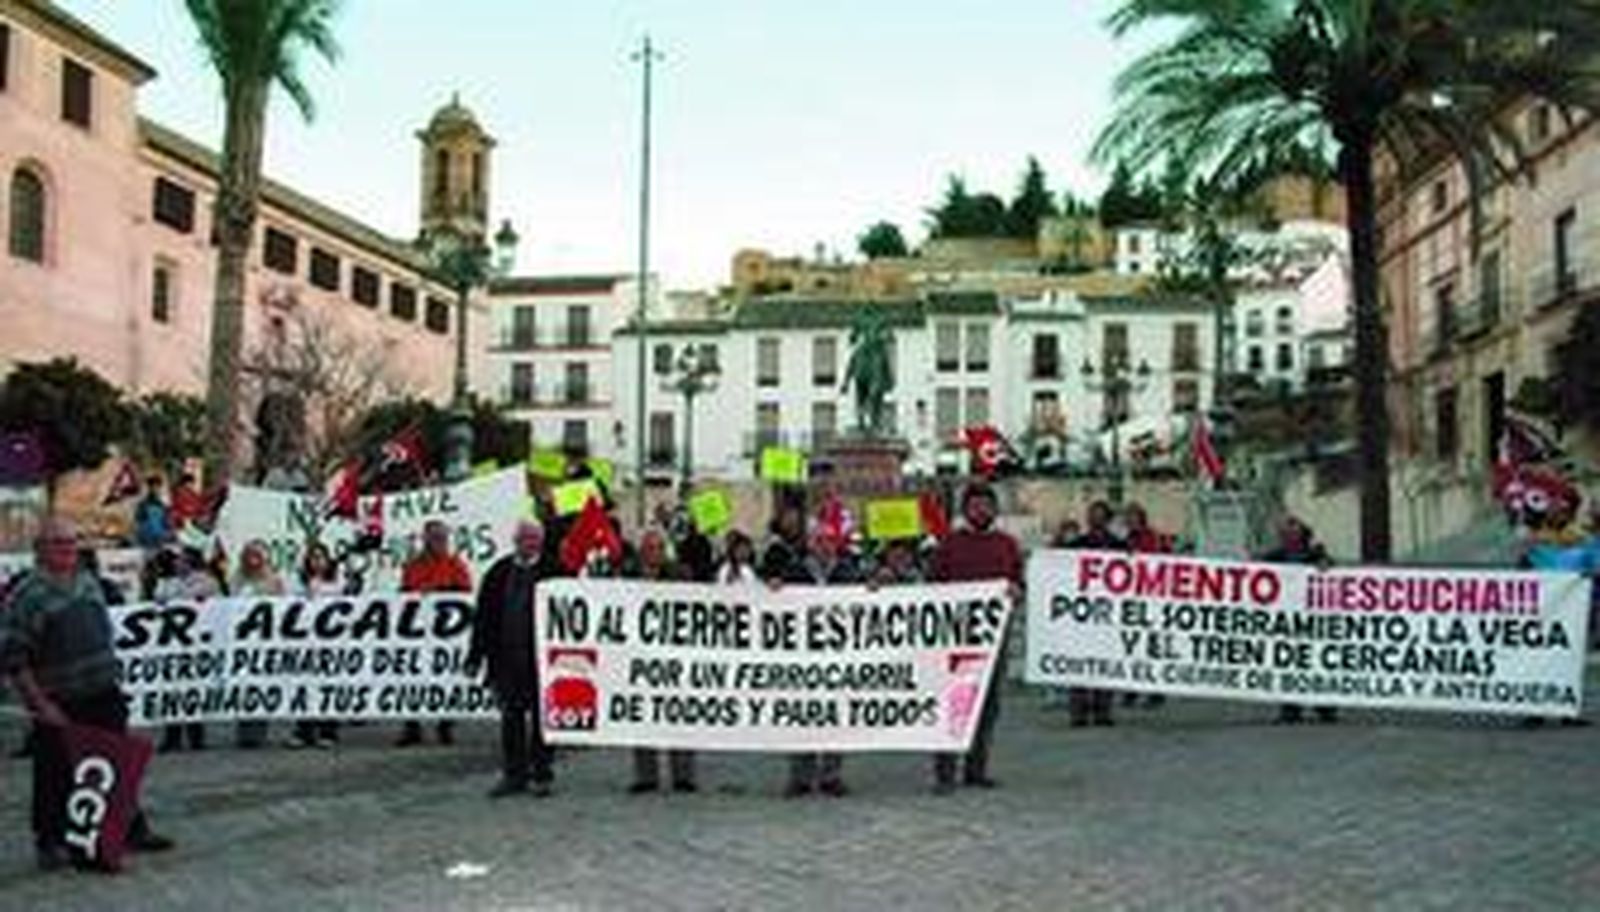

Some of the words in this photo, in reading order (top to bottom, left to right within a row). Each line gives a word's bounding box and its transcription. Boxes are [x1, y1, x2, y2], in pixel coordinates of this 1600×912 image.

[1078, 559, 1281, 604] FOMENTO
[115, 606, 212, 648] SR.
[235, 600, 472, 641] ALCALD
[547, 596, 589, 642] NO
[597, 605, 627, 642] AL
[639, 600, 750, 648] CIERRE
[761, 611, 797, 649] DE
[807, 599, 1004, 650] ESTACIONES
[1051, 596, 1112, 626] POR
[1121, 601, 1150, 628] EL
[1428, 618, 1468, 645] LA
[1479, 620, 1570, 649] VEGA
[231, 648, 364, 678] PLENARIO
[371, 647, 421, 676] DEL
[1121, 632, 1140, 656] Y
[1146, 634, 1181, 661] EL
[1190, 637, 1264, 666] TREN
[1274, 643, 1312, 671] DE
[629, 658, 683, 688] POR
[690, 661, 728, 688] UN
[733, 663, 916, 690] FERROCARRIL
[1039, 654, 1126, 679] CONTRA
[1132, 661, 1156, 683] EL
[1247, 668, 1273, 692] DE
[290, 686, 308, 713] A
[319, 686, 371, 713] TUS
[608, 694, 644, 723] DE
[650, 697, 740, 726] TODOS
[745, 699, 765, 725] Y
[771, 698, 839, 727] PARA
[847, 697, 939, 727] TODOS
[65, 757, 115, 860] CGT
